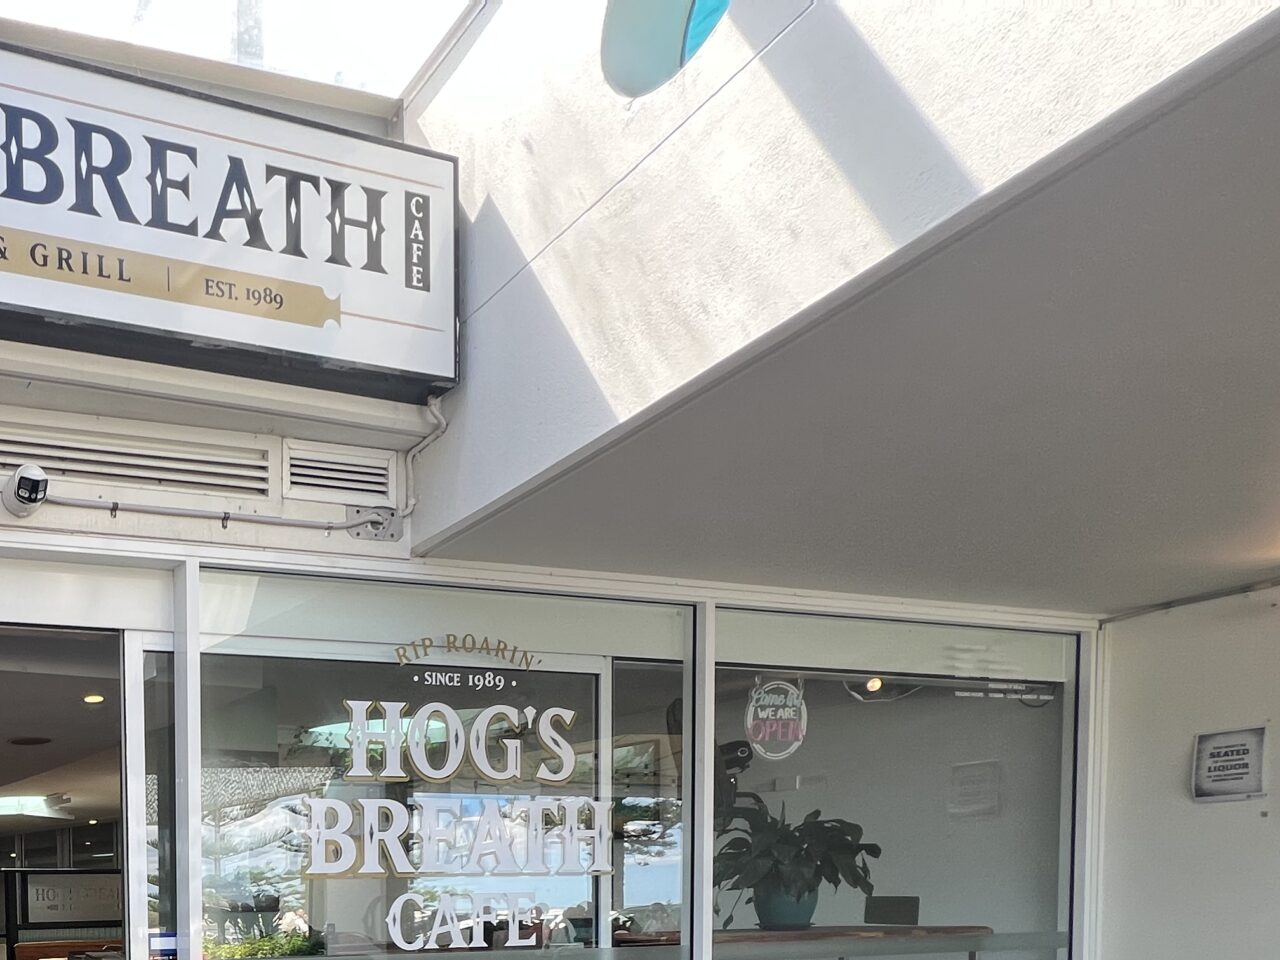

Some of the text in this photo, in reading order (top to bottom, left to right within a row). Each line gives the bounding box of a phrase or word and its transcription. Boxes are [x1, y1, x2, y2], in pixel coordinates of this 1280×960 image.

[409, 197, 425, 288] CAFE
[29, 242, 132, 284] GRILL
[204, 278, 239, 301] EST.
[245, 287, 284, 310] 1989
[394, 633, 543, 672] RIP ROARIN'
[424, 671, 505, 691] SINCE 1989
[750, 719, 802, 742] OPEN
[757, 707, 798, 719] WE ARE
[342, 698, 578, 786] HOG'S
[1207, 762, 1250, 773] LIQUOR
[304, 797, 615, 879] BREATH
[385, 891, 538, 952] CAFE
